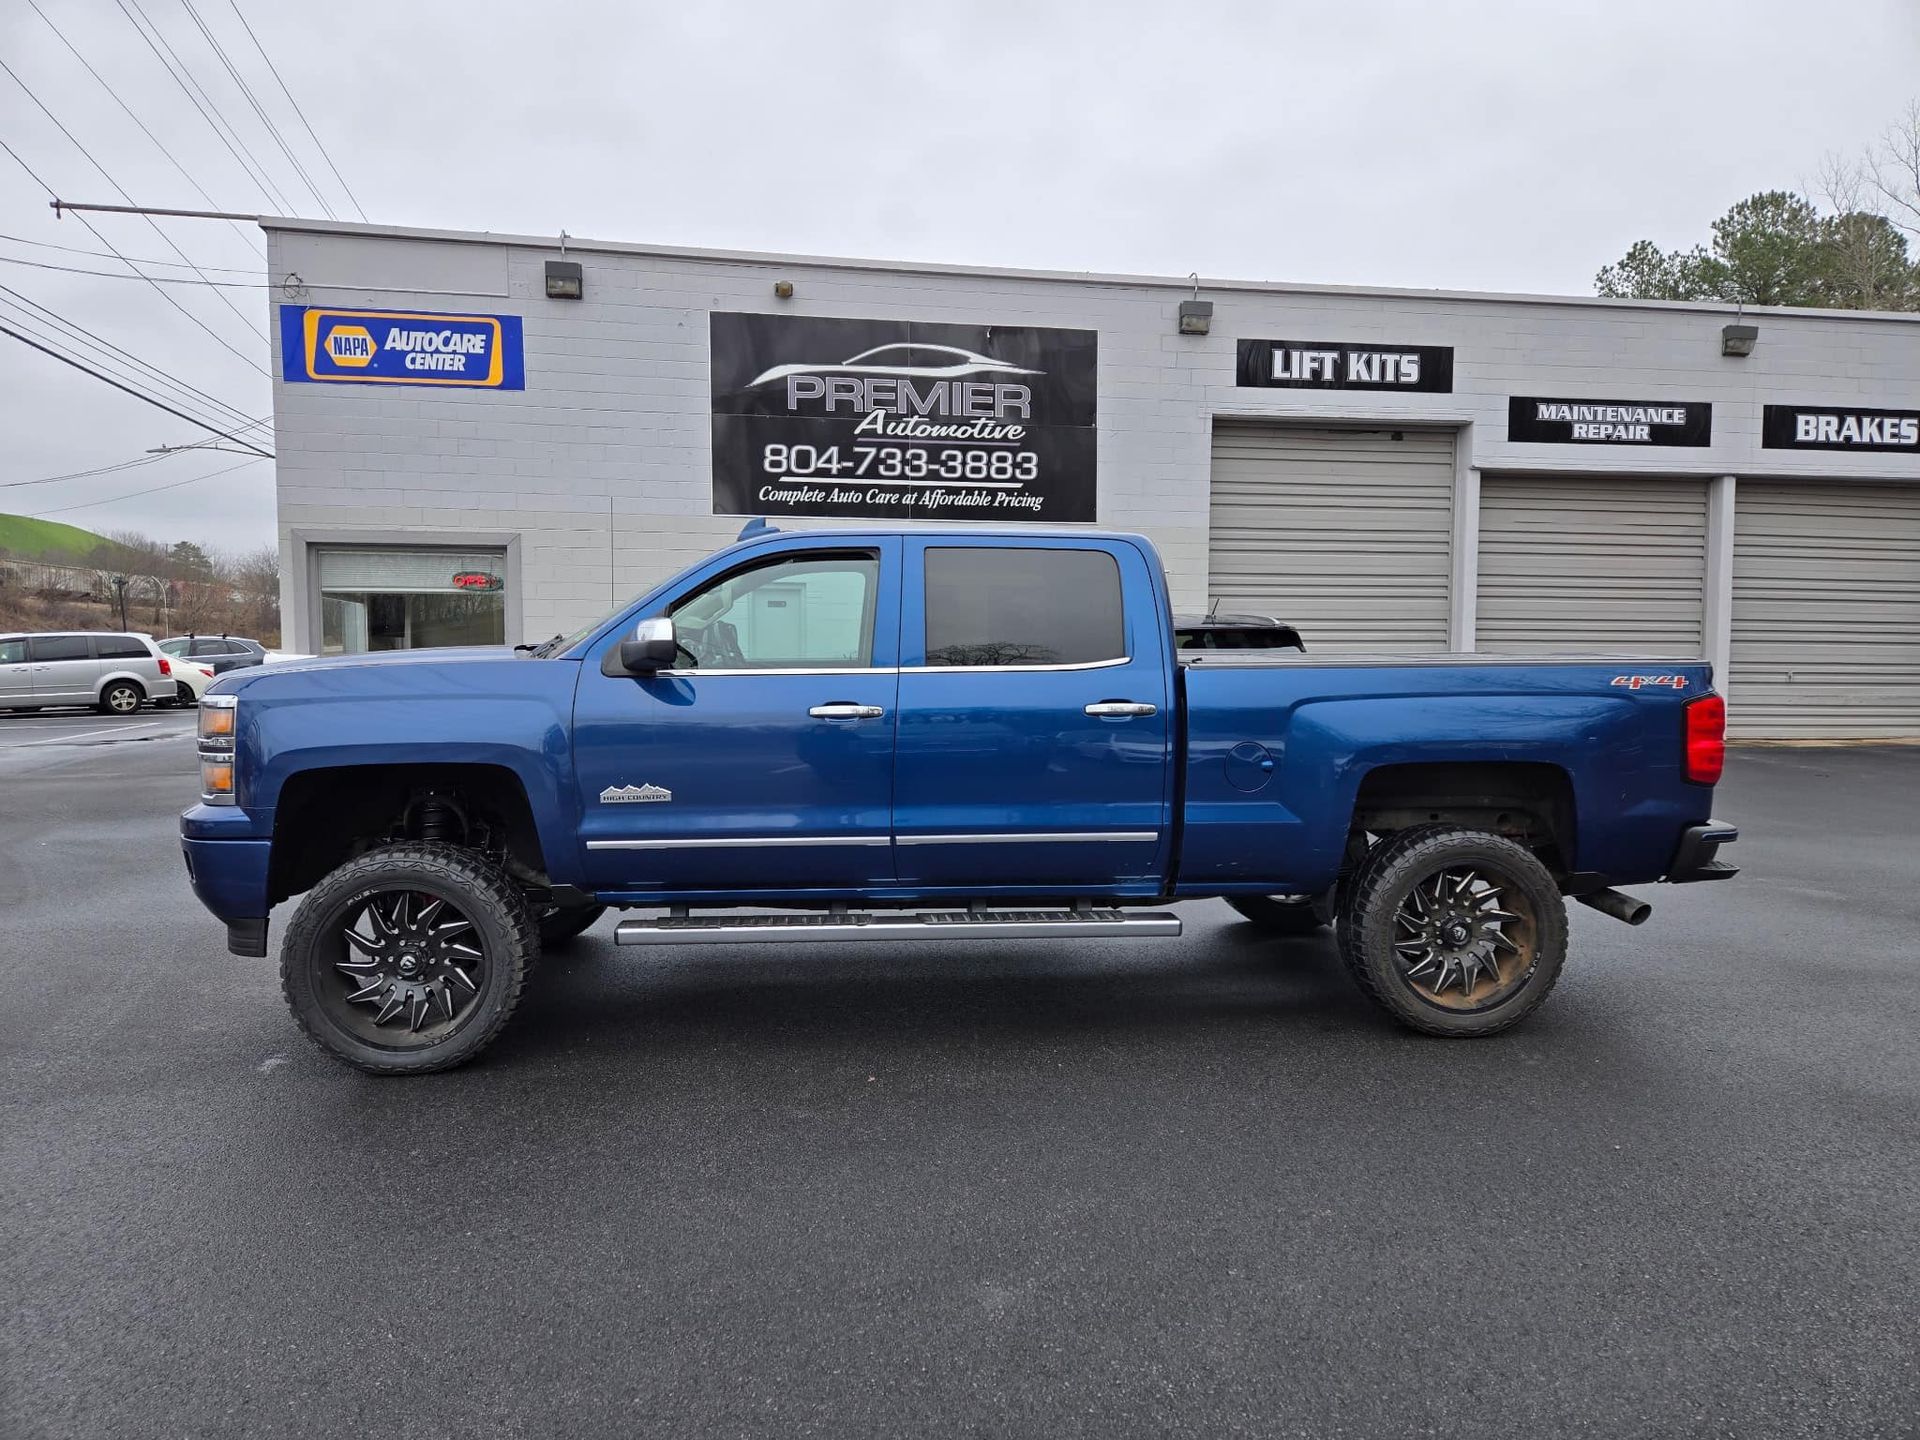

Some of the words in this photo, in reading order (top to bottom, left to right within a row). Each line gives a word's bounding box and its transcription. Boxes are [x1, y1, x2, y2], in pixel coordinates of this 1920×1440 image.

[333, 335, 370, 357] NAPA
[405, 352, 465, 372] CENTER
[1271, 348, 1341, 382] LIFT
[1346, 350, 1421, 385] KITS
[786, 374, 1032, 420] PREMIER
[854, 408, 1027, 440] Automotive
[1536, 402, 1687, 426] MAINTENANCE
[1571, 421, 1652, 442] REPAIR
[1795, 412, 1920, 446] BRAKES
[762, 443, 1040, 481] 804-733-3883
[758, 485, 826, 506] Complete
[826, 487, 863, 504] Auto
[865, 488, 900, 504] Care
[902, 491, 918, 505] at
[918, 489, 992, 509] Affordable
[993, 491, 1044, 511] Pricing
